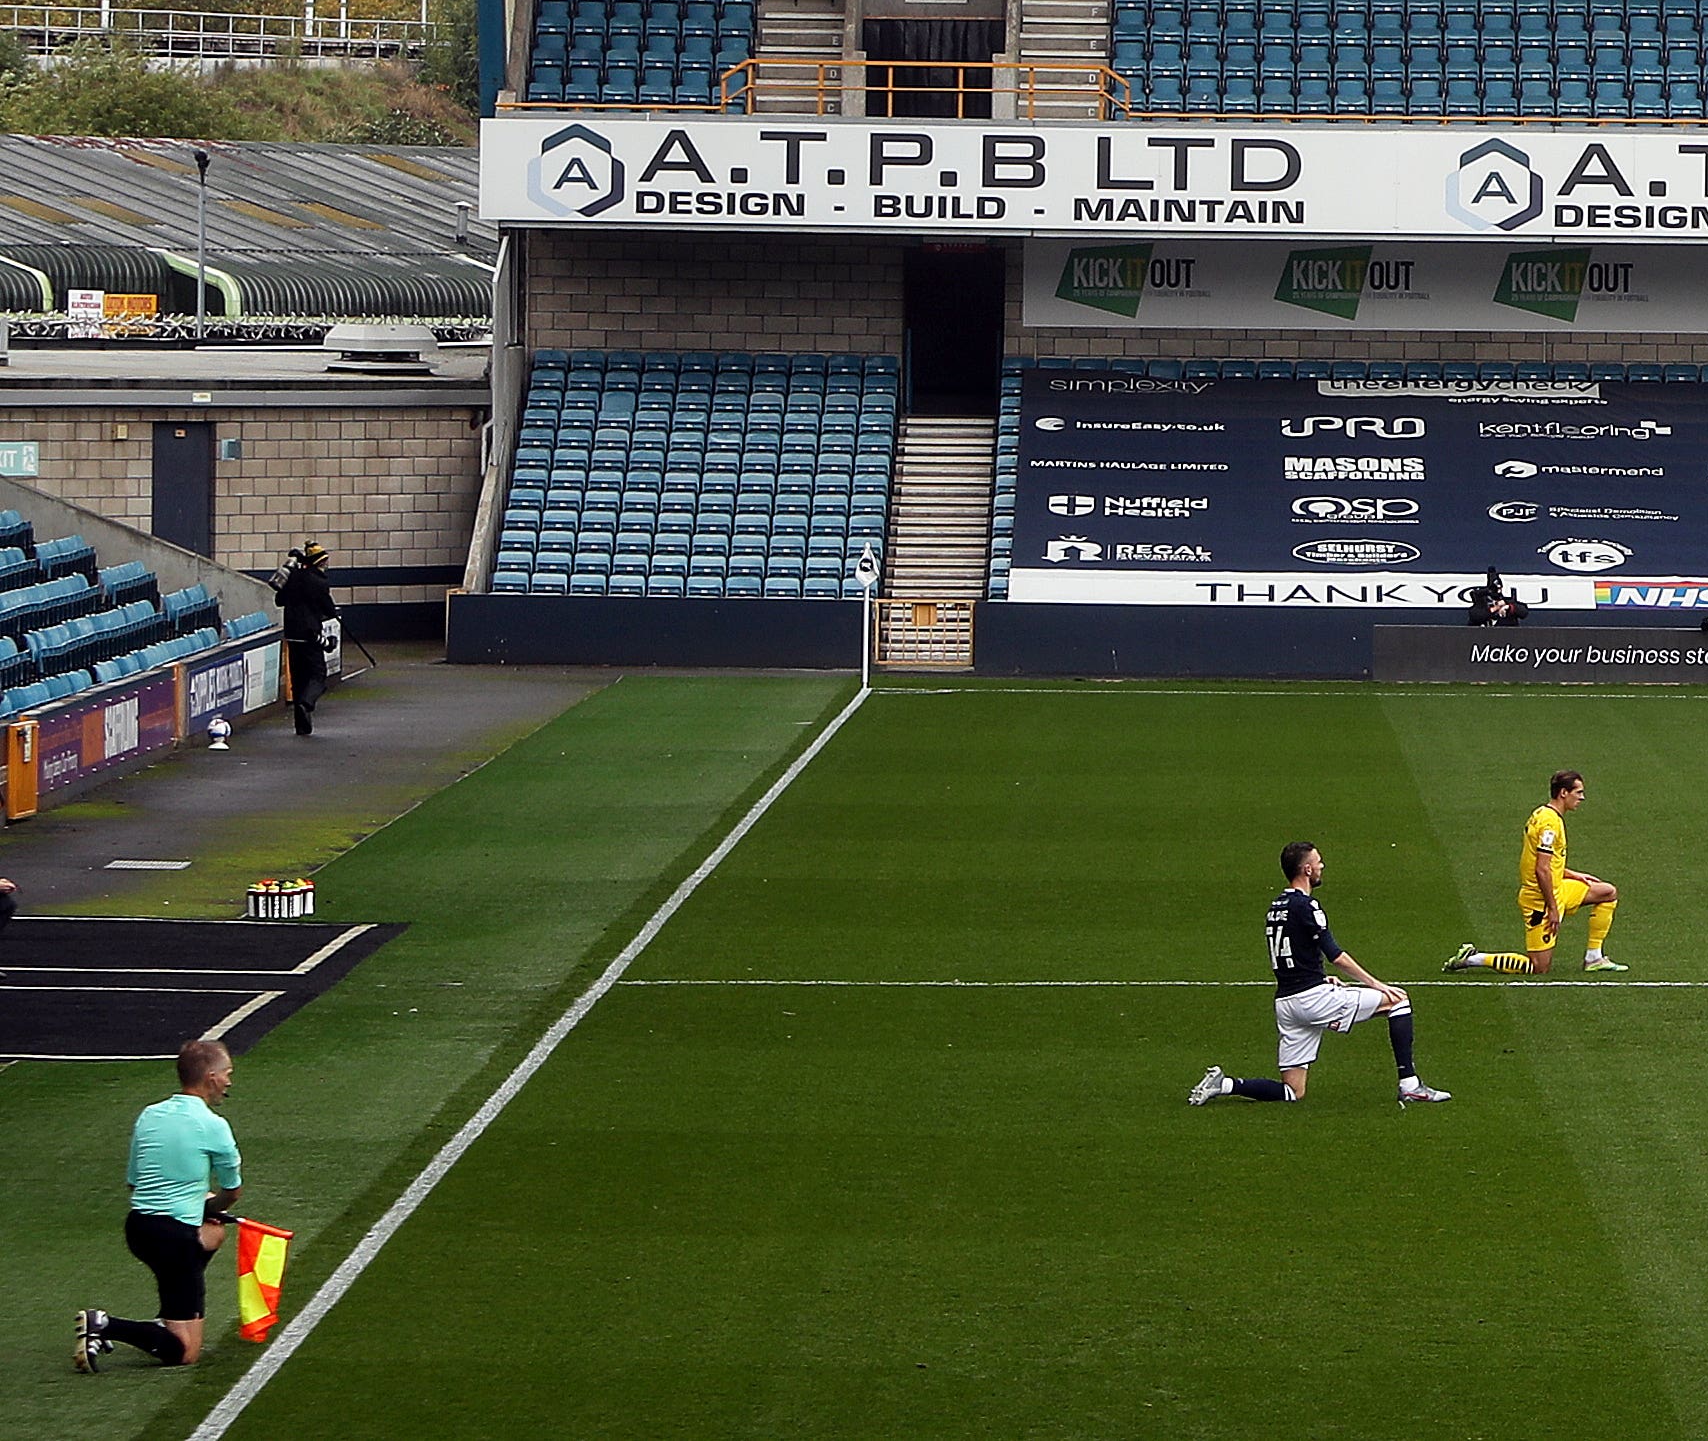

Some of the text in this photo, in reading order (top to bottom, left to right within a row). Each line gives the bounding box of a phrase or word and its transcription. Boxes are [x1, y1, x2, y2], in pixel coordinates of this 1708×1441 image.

[1097, 137, 1301, 191] LTD
[636, 191, 1304, 223] DESIGN BUILD MAINTAIN
[1073, 258, 1195, 289] KICK OUT
[1292, 260, 1415, 291] KICK OUT
[1511, 262, 1634, 293] KICK OUT
[1049, 377, 1207, 394] simplexity
[1030, 460, 1229, 472] MARTINS HAULAGE LIMITED
[1284, 457, 1425, 472] MASONS
[1285, 471, 1425, 481] SCAFFOLDING
[1104, 496, 1209, 509] Nuffield
[1104, 506, 1191, 518] Health
[1502, 507, 1537, 517] PJF
[1116, 543, 1212, 555] REGAL
[1317, 543, 1397, 553] SELHURST
[1558, 549, 1617, 565] tfs
[1195, 583, 1408, 604] THANK
[1471, 644, 1528, 663] Make
[1534, 648, 1583, 669] your
[1587, 645, 1681, 664] business
